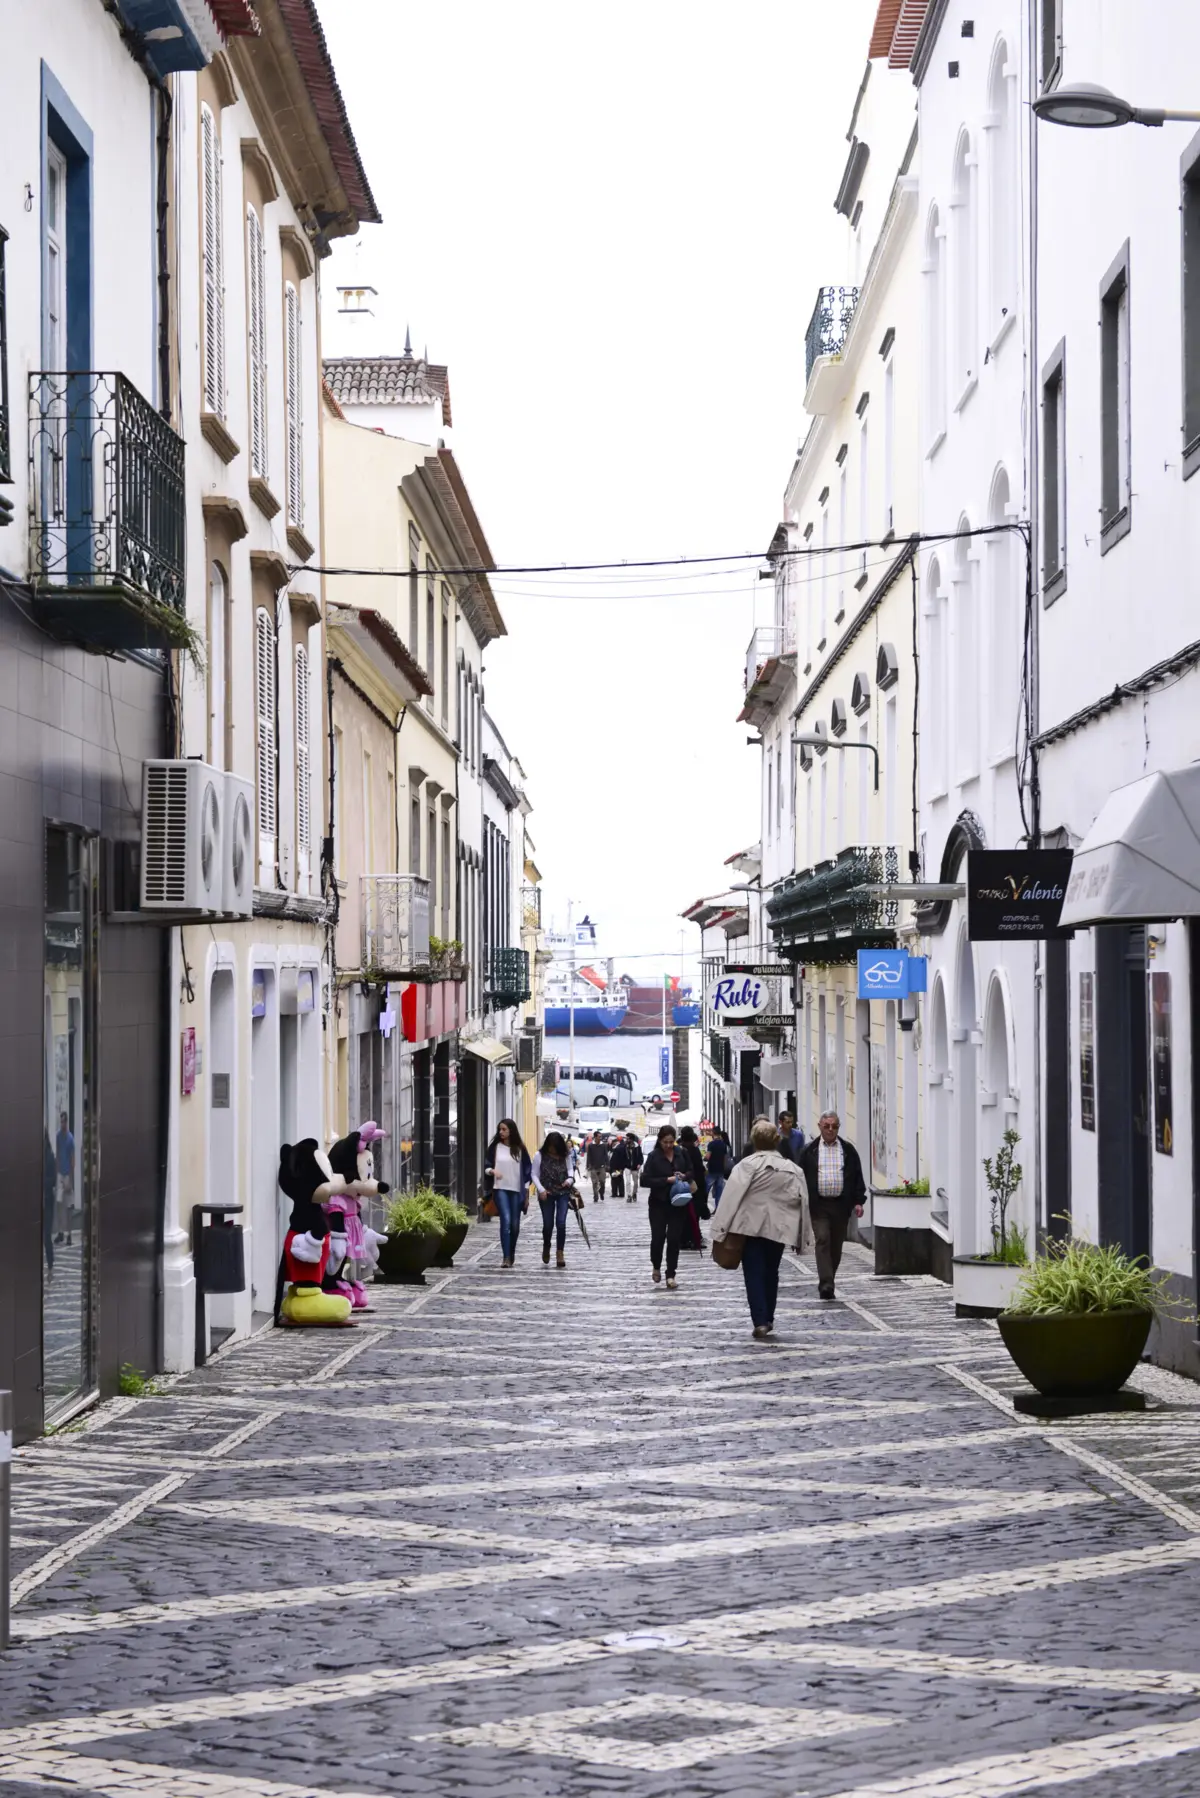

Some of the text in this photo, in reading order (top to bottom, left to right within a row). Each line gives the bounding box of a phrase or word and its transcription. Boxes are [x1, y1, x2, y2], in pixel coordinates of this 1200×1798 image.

[1004, 875, 1063, 901] Valente
[712, 978, 762, 1011] Rubi
[754, 1015, 794, 1026] relojoaria
